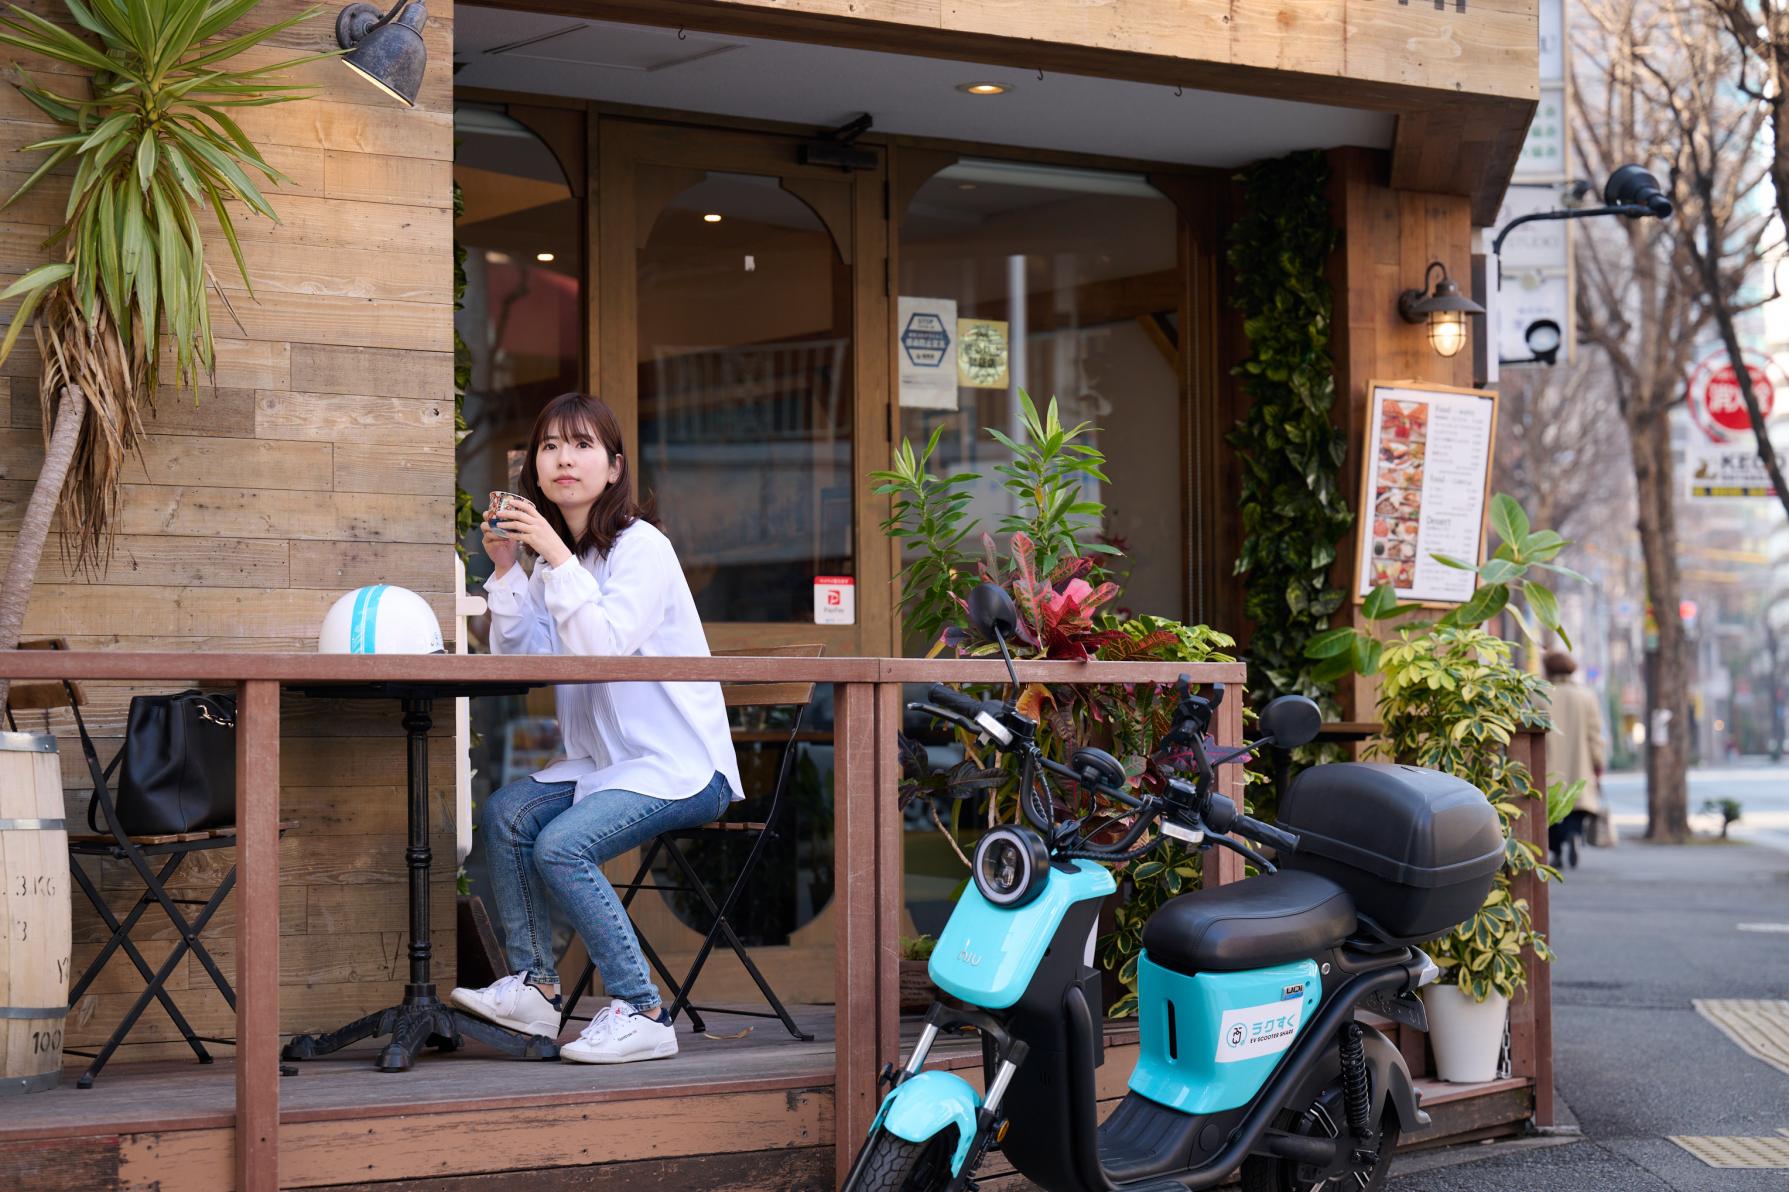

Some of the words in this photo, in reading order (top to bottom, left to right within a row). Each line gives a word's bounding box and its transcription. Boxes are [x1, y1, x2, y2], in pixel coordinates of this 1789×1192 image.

[1251, 1014, 1296, 1036] ラクすく
[1257, 1032, 1280, 1042] SCOOTER
[1279, 1029, 1294, 1037] SHARE
[33, 1031, 62, 1055] 100
